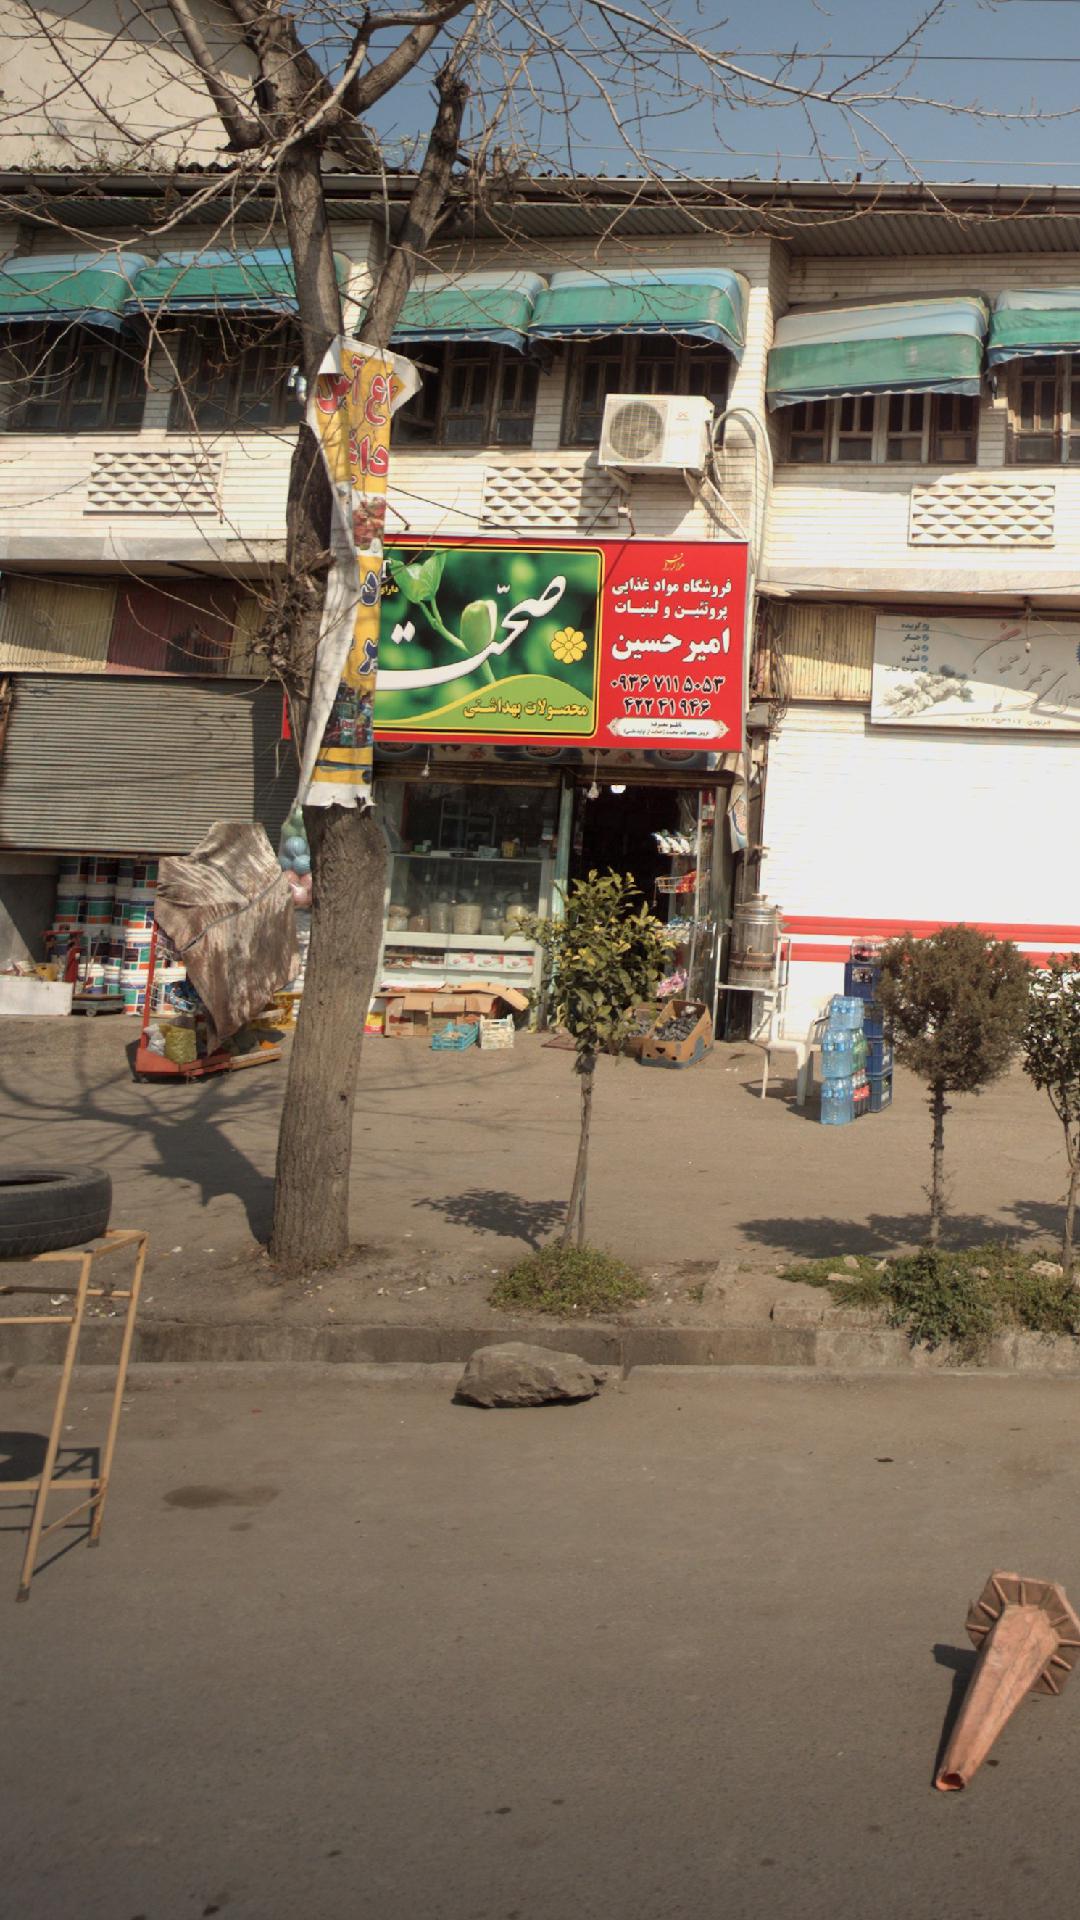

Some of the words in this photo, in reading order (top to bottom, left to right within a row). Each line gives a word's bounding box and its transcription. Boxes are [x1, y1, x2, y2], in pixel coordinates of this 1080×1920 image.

[611, 576, 650, 595] غذایی
[653, 578, 679, 596] مواد
[683, 578, 732, 598] فروشگاه
[614, 599, 659, 617] لبنیات
[663, 605, 671, 618] و
[653, 675, 680, 692] ۷۱۱
[463, 697, 522, 719] بهداشتی
[525, 699, 589, 721] محصولات
